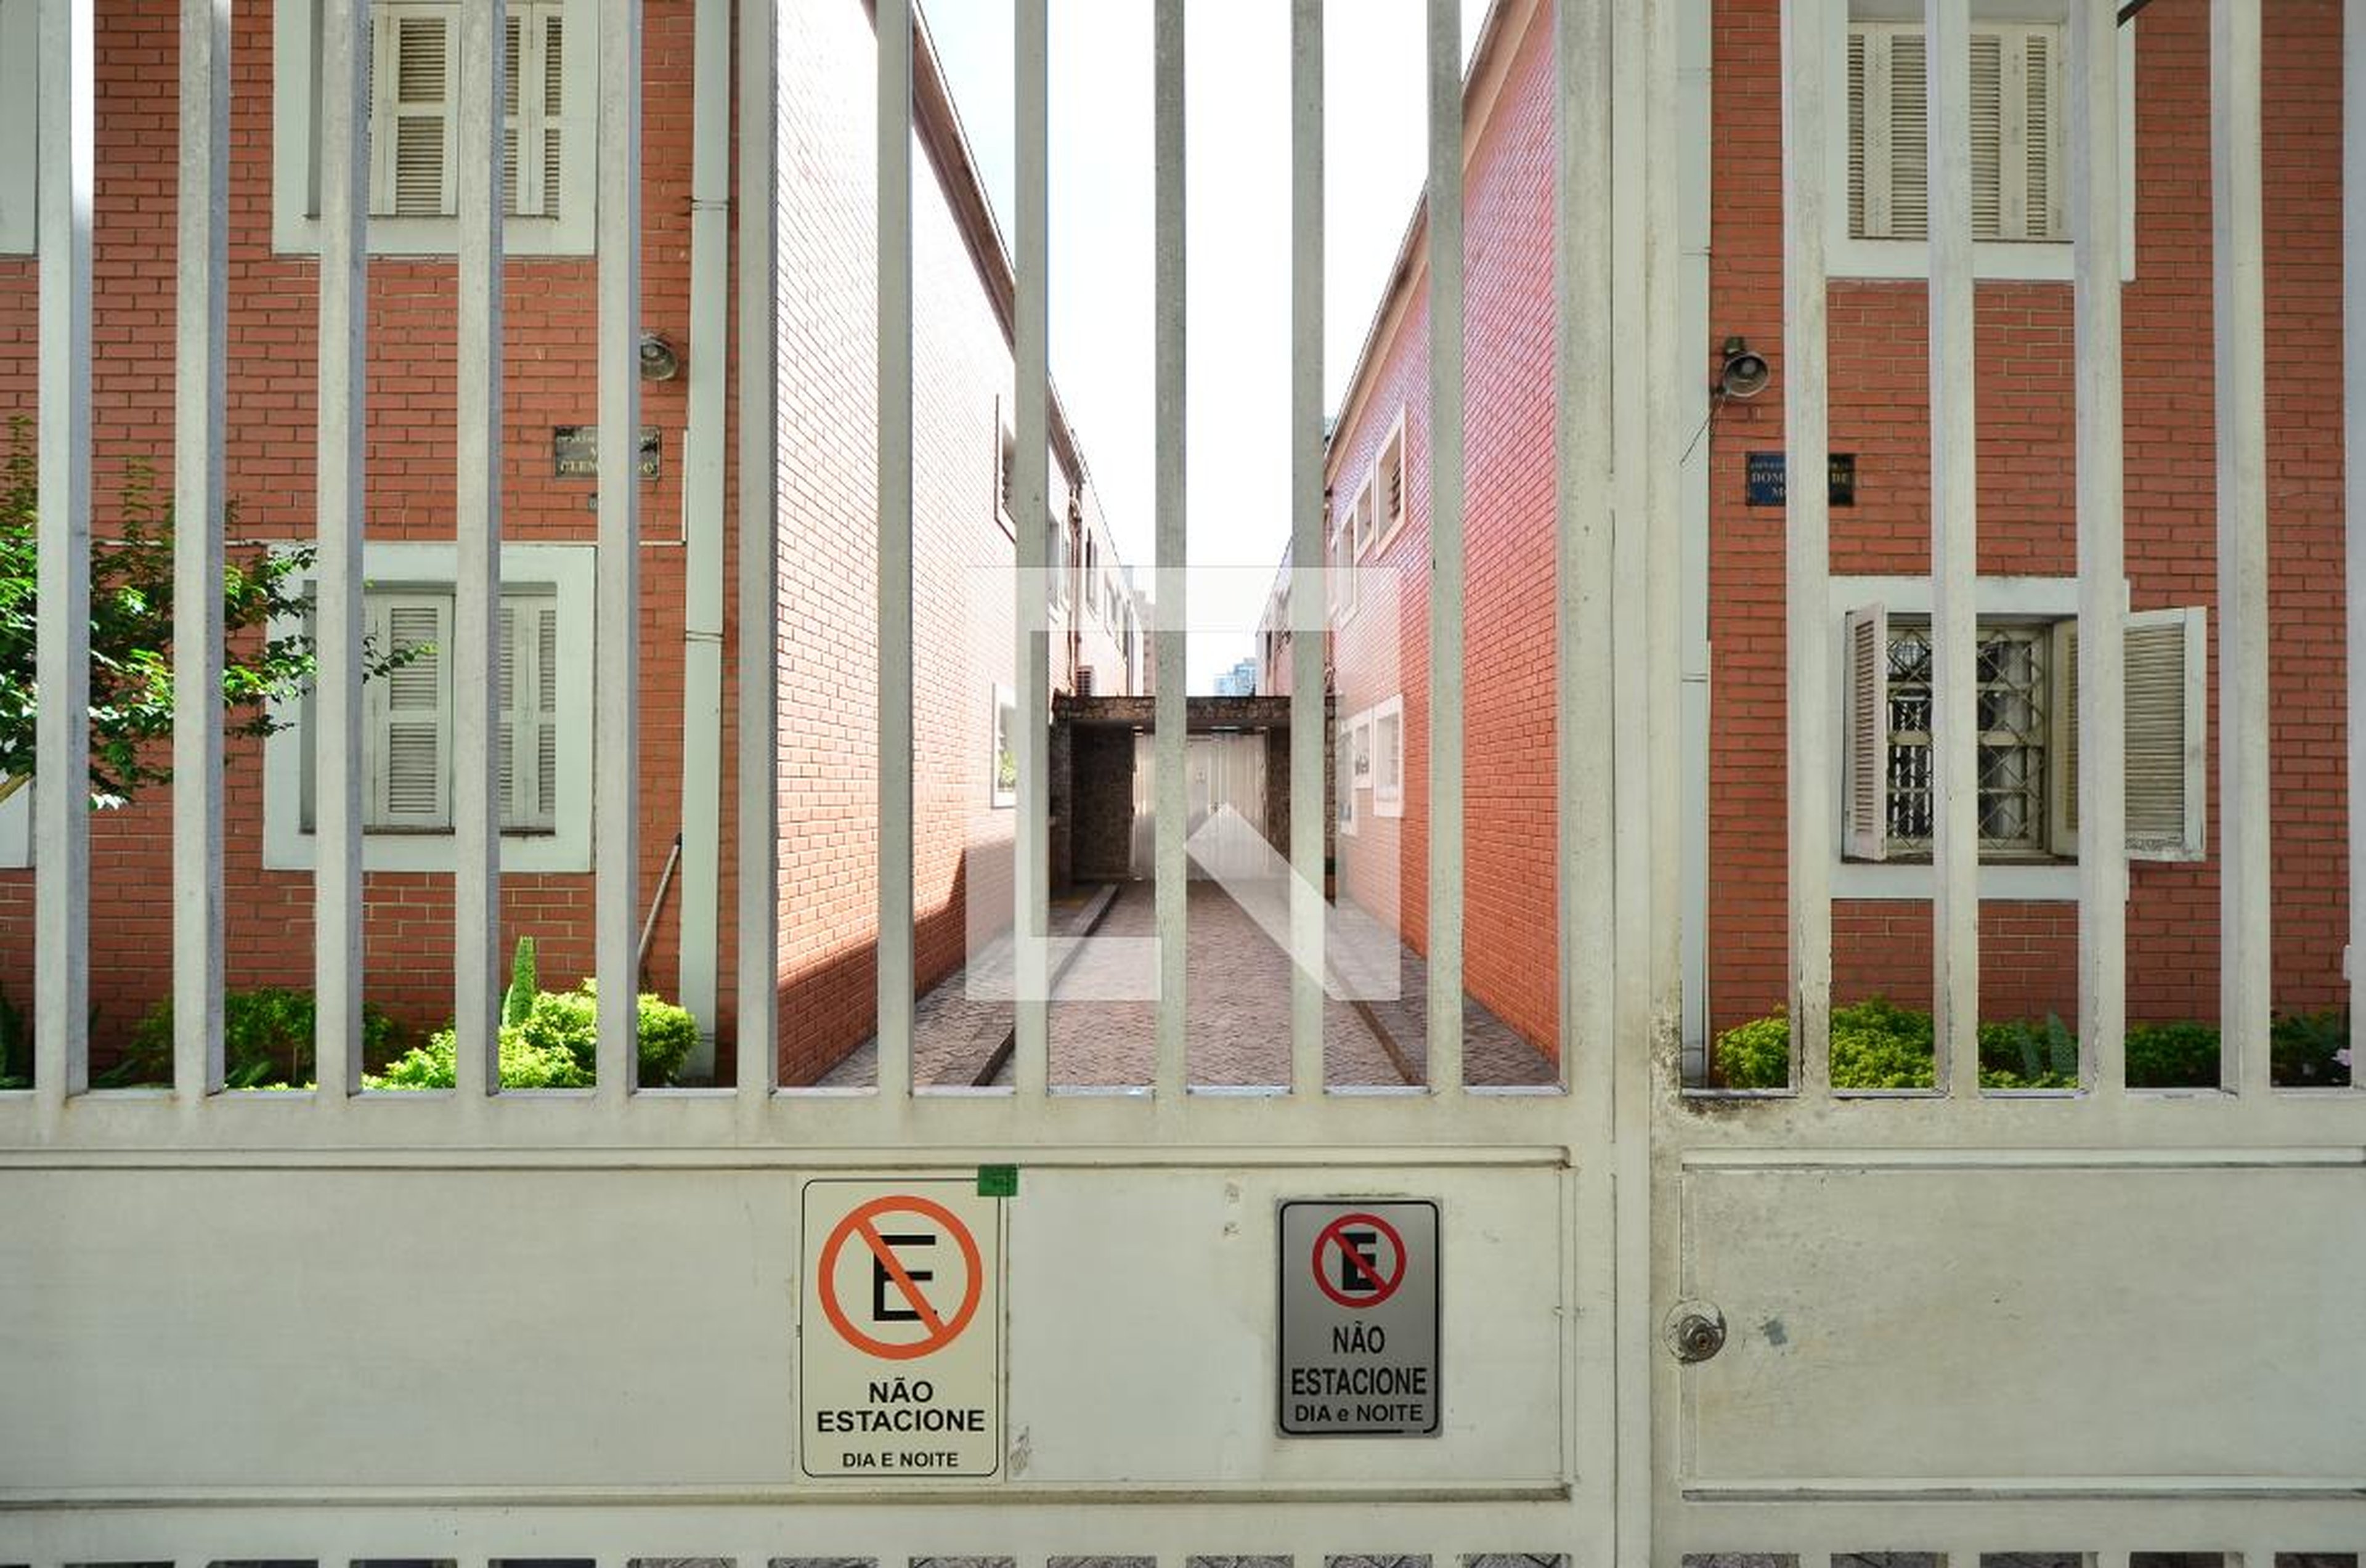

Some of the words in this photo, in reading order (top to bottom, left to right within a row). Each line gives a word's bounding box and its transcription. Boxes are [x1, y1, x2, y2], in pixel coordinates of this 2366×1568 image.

[1341, 1232, 1377, 1291] E
[874, 1235, 938, 1321] E
[1333, 1320, 1385, 1354] NÃO
[869, 1377, 933, 1403] NÃO
[1291, 1367, 1428, 1396] ESTACIONE
[817, 1408, 985, 1432] ESTACIONE
[1295, 1404, 1333, 1422] DIA
[1336, 1408, 1350, 1422] e
[1356, 1403, 1424, 1422] NOITE
[842, 1452, 877, 1468] DIA
[881, 1452, 893, 1468] E
[900, 1452, 959, 1468] NOITE
